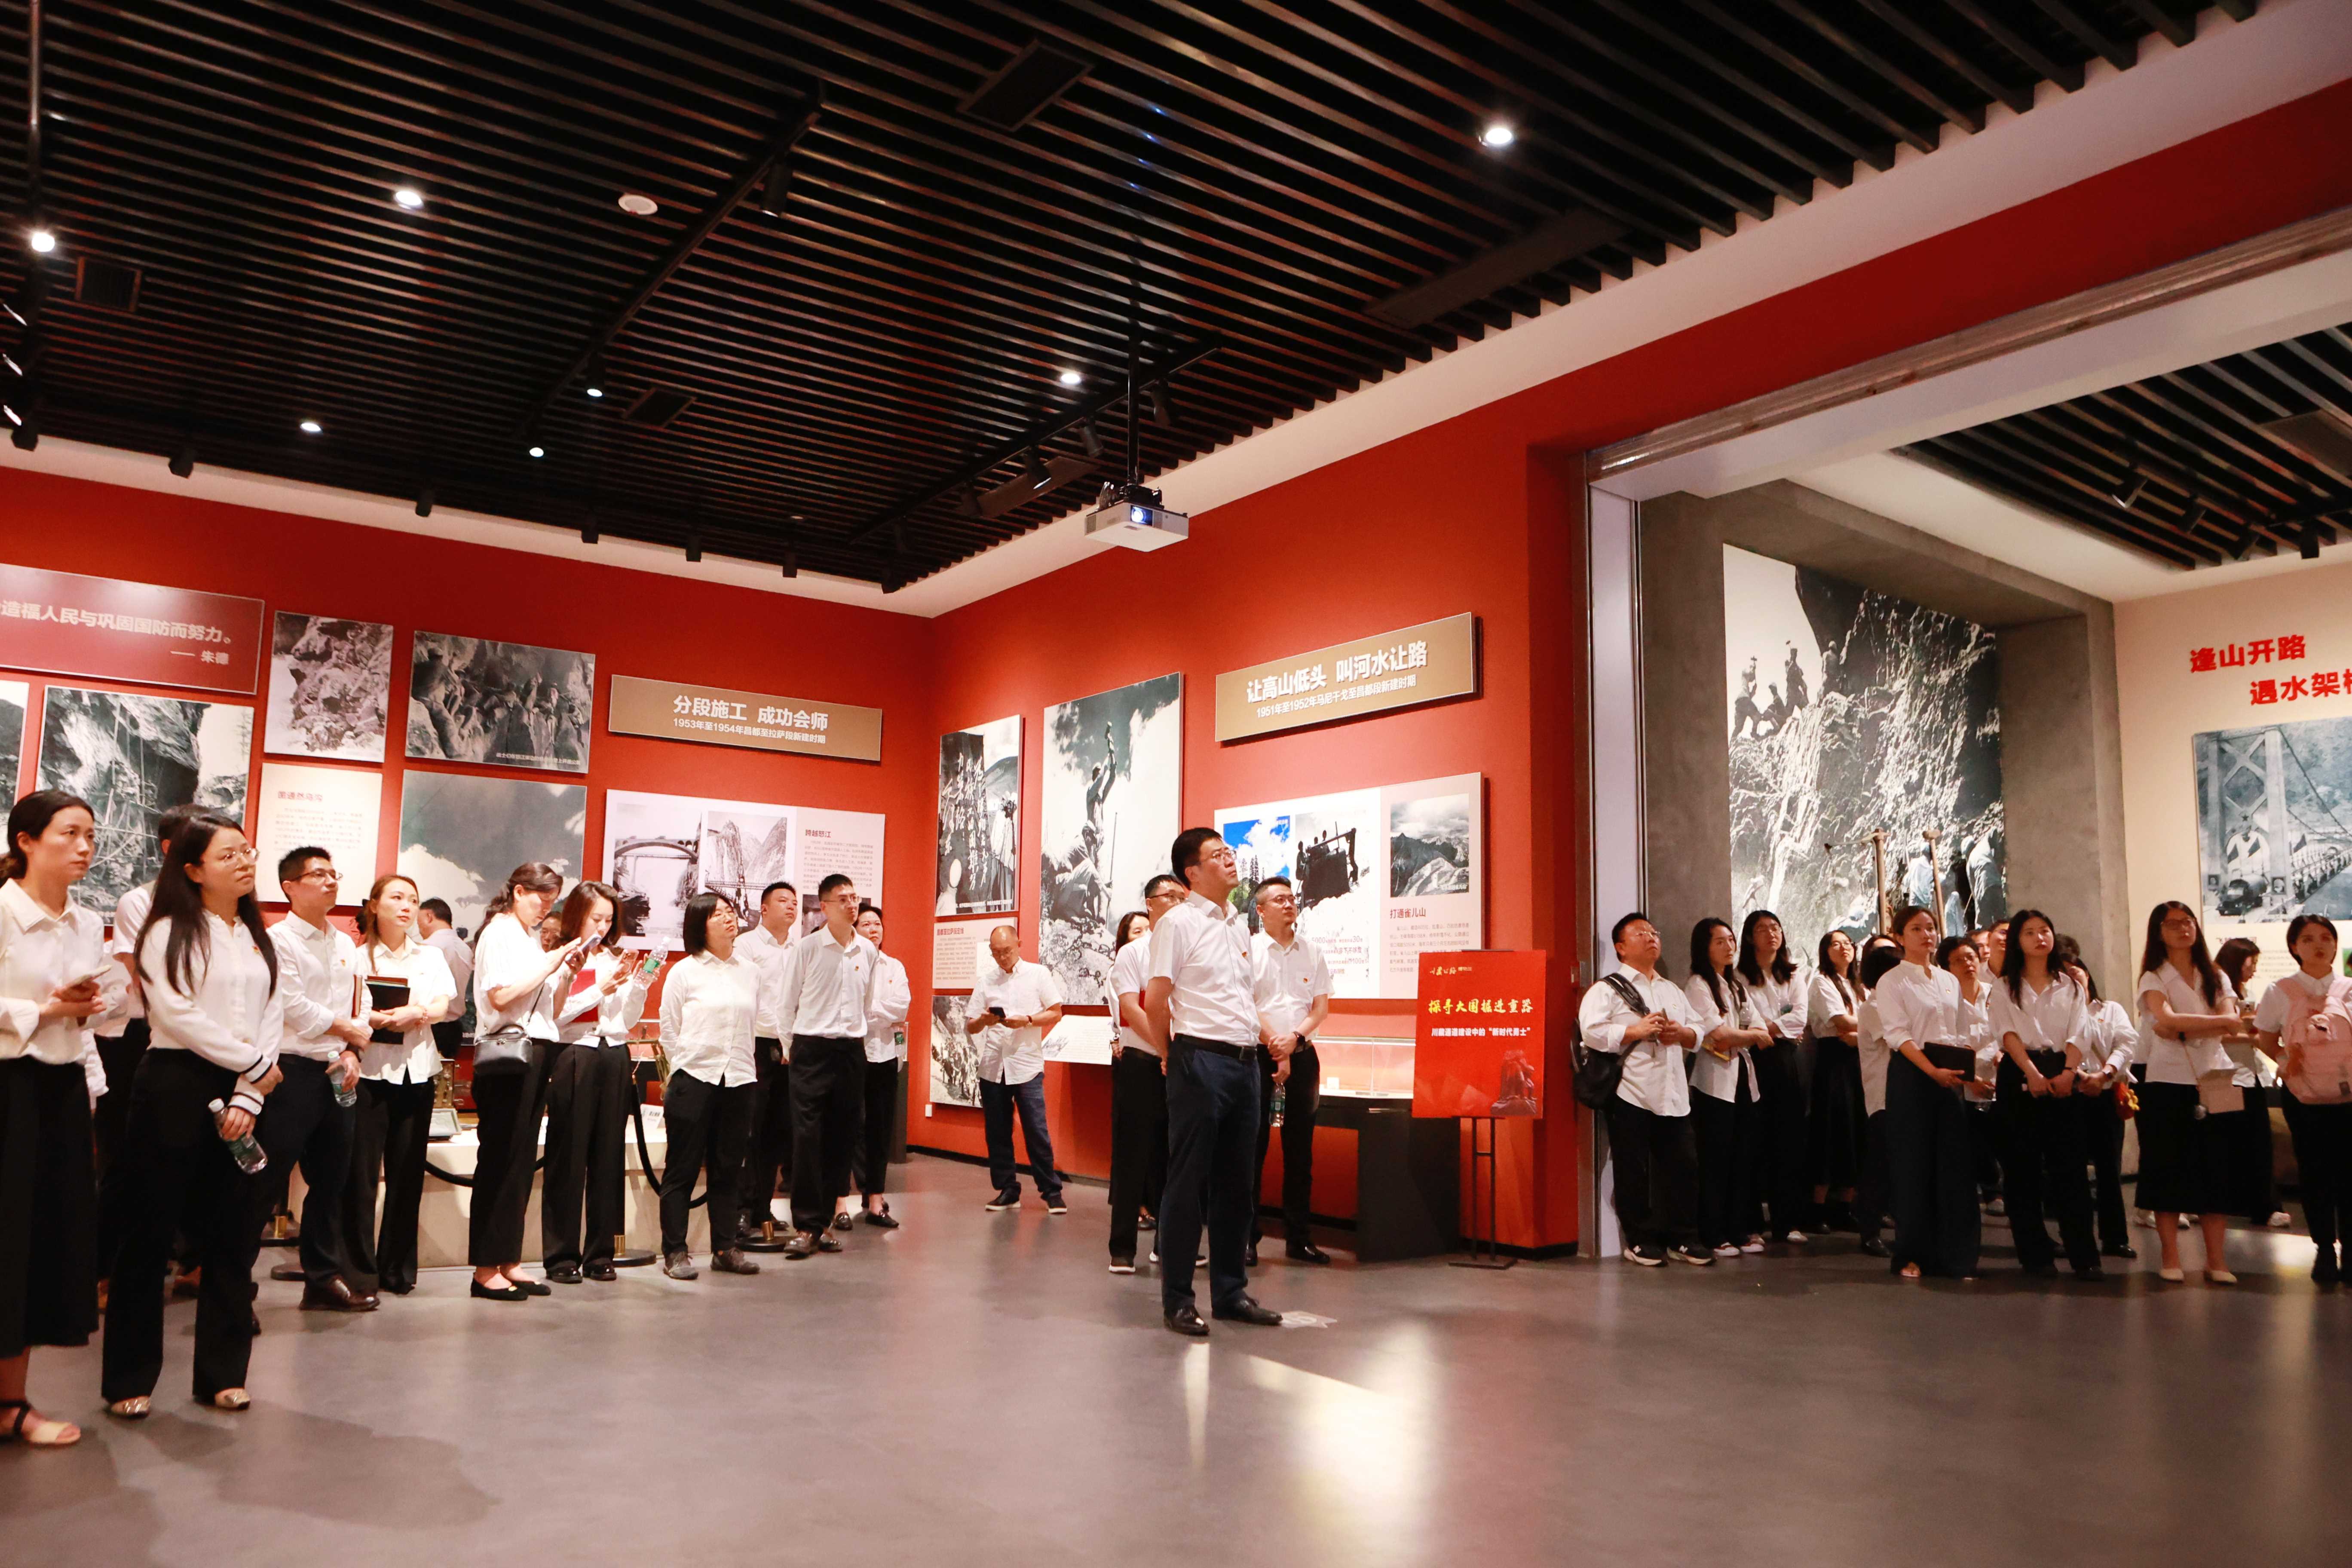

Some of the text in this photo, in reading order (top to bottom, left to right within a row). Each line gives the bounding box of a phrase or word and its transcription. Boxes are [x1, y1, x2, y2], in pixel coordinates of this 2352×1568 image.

[2190, 634, 2306, 674] 逢山开路
[1247, 640, 1427, 704] 让高山低头 叫河水让路
[1256, 674, 1416, 718] 1951年至1952年马尼干戈至昌都段新建时期
[673, 695, 829, 732] 分段施工 成功会师
[673, 718, 826, 744] 1953年至1954年昌都至拉萨段新建时期
[805, 829, 831, 838] 跨越怒江
[1390, 907, 1426, 919] 打通雀儿山
[1428, 998, 1533, 1014] 探寻大国掘进重器
